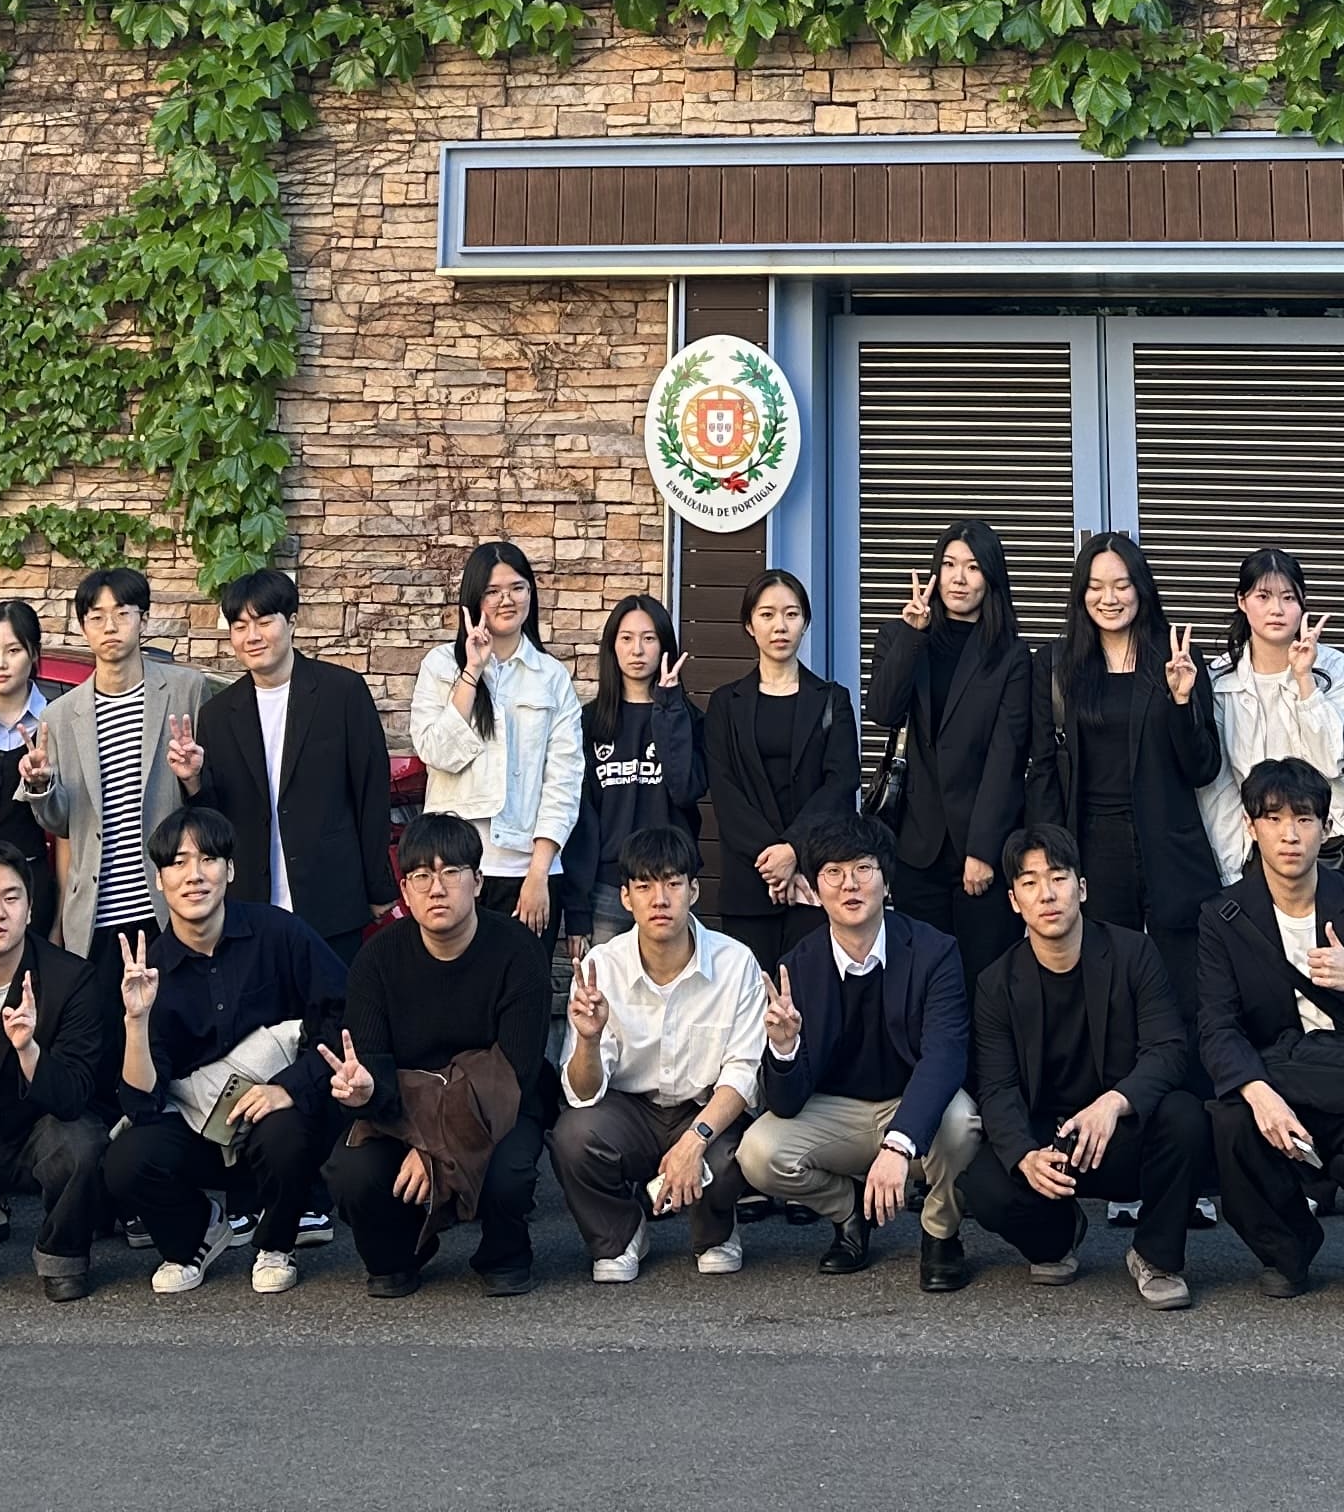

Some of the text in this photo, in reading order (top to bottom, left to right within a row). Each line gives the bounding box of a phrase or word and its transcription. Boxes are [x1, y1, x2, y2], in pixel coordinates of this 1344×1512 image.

[666, 480, 777, 517] EMBAIXADA DE PORTUGAL
